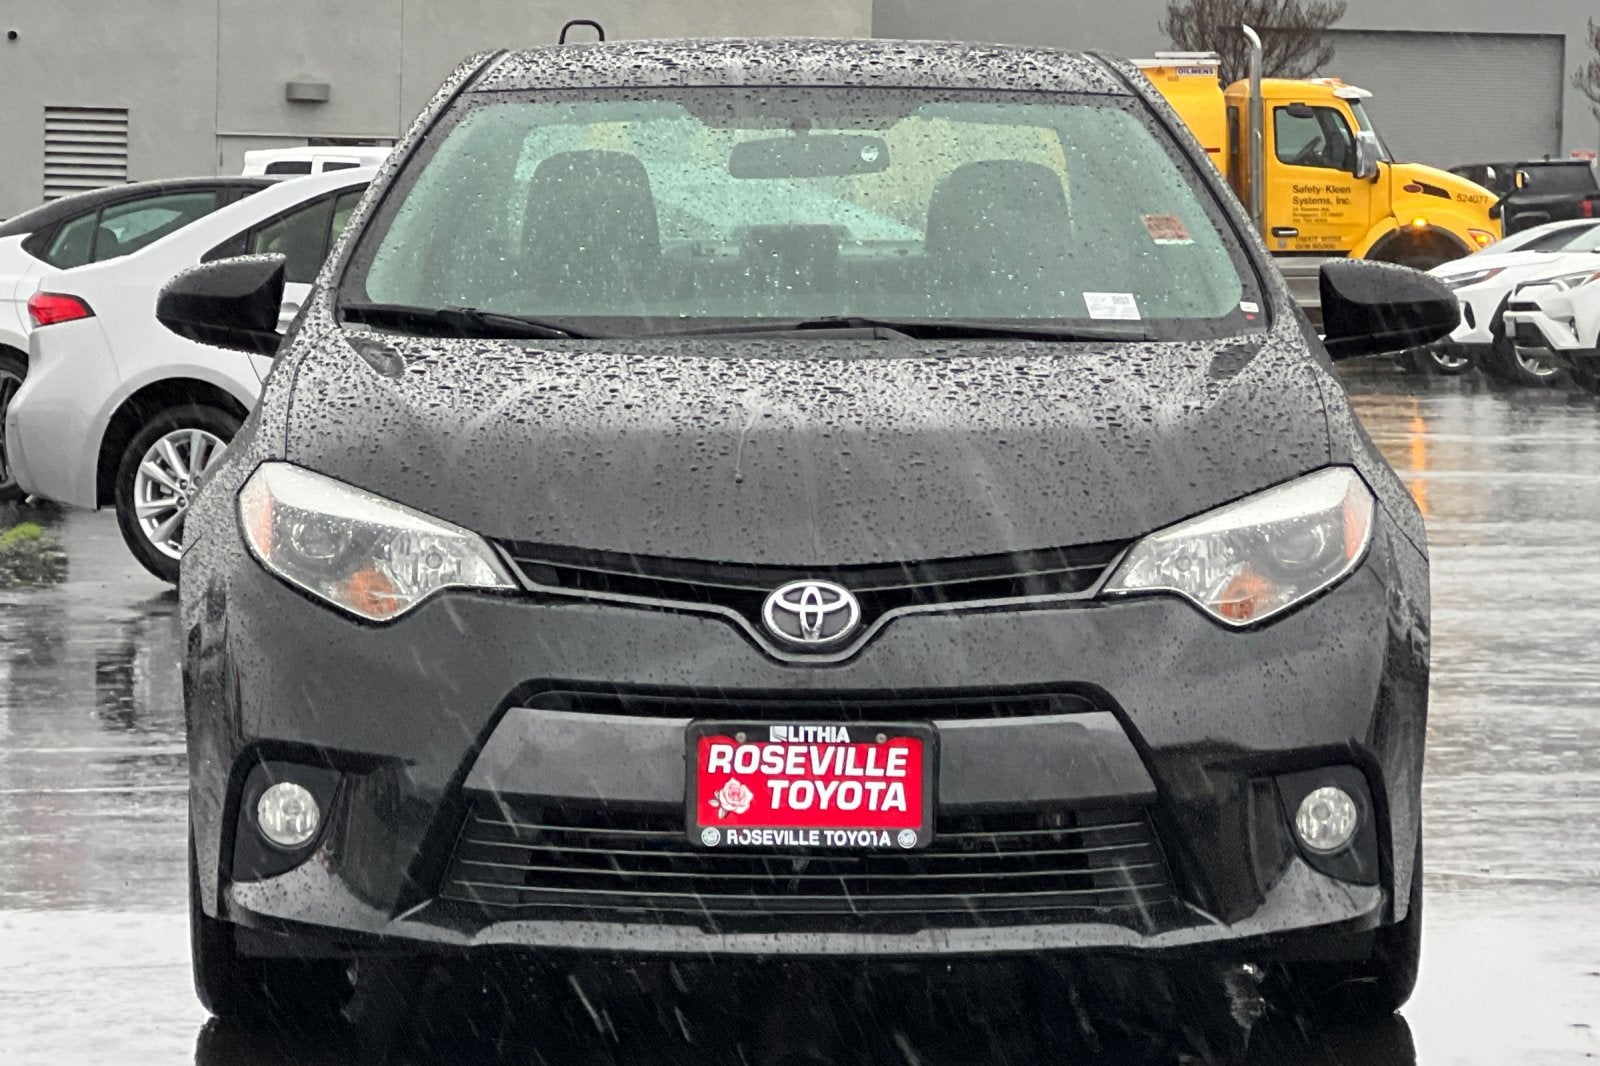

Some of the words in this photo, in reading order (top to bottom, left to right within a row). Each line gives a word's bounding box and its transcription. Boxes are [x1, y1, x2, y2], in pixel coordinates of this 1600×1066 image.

[1292, 196, 1333, 206] Systems,
[1336, 196, 1352, 205] Inc.
[1456, 193, 1489, 204] 524077
[788, 726, 850, 743] LITHIA
[707, 744, 909, 777] ROSEVILLE
[767, 779, 907, 812] TOYOTA
[726, 829, 820, 845] ROSEVILLE
[824, 830, 891, 847] TOYOTA
